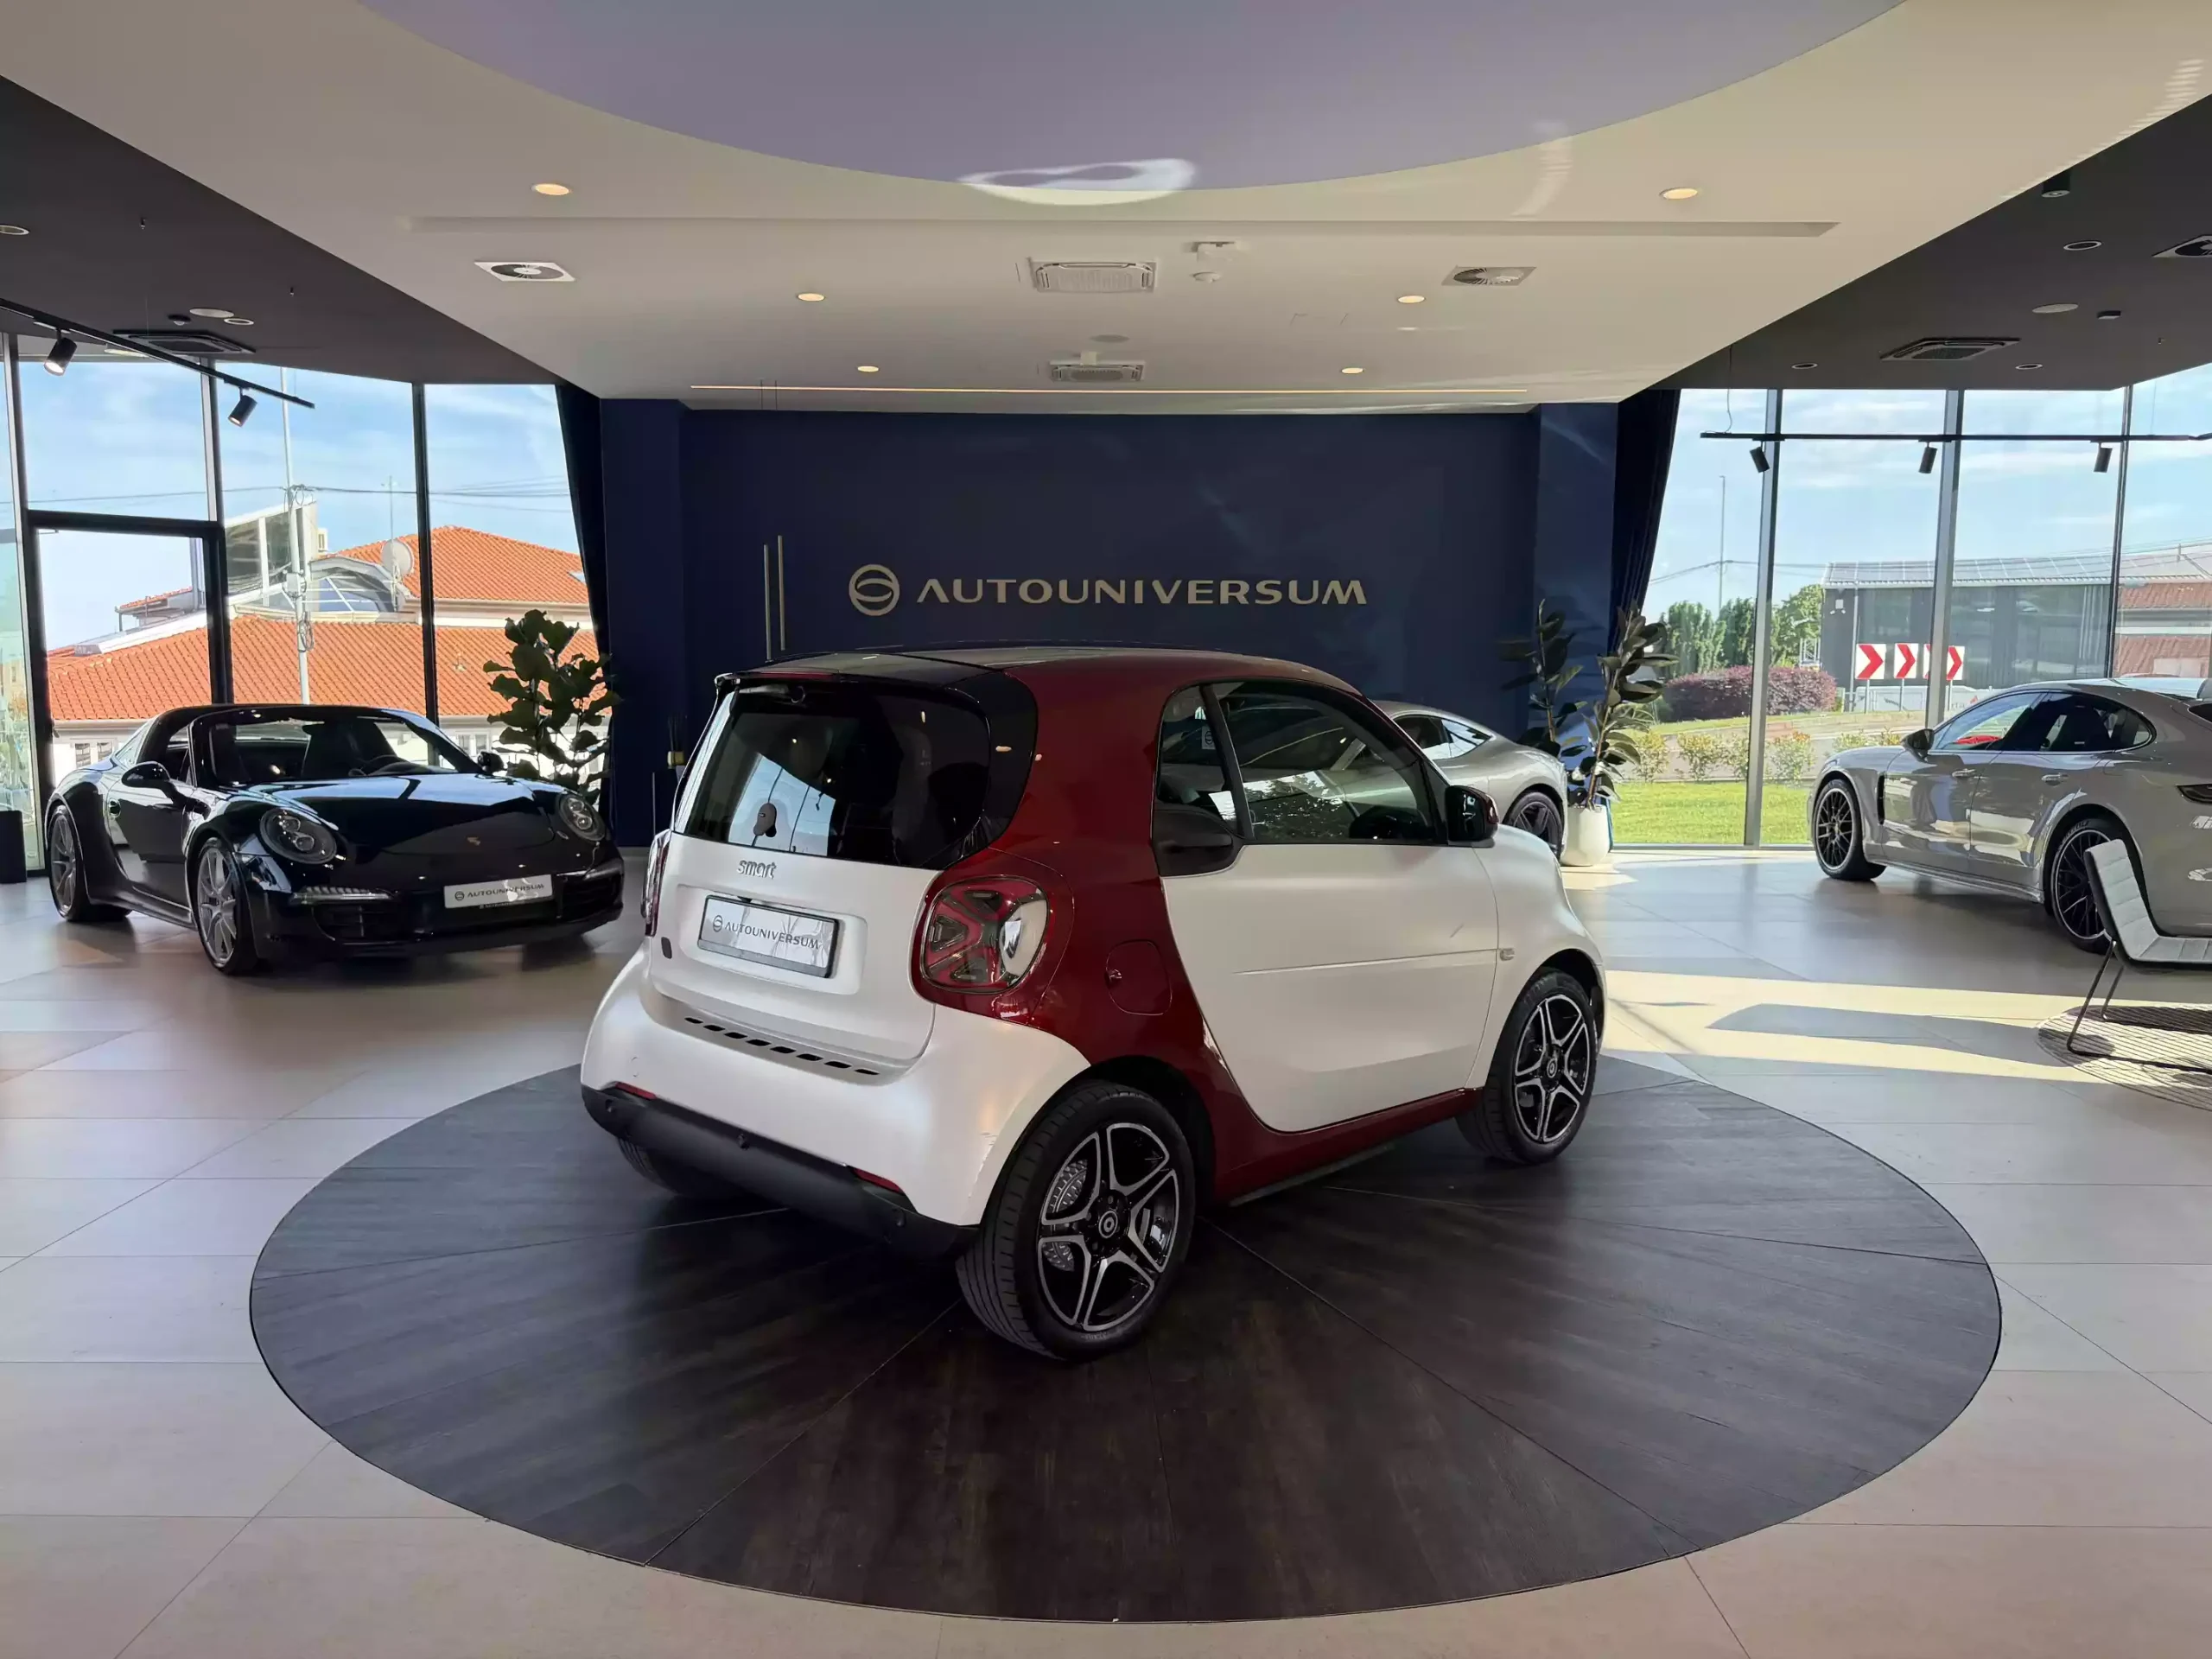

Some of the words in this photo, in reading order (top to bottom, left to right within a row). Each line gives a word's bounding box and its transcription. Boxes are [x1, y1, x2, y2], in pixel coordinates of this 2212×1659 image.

[917, 579, 1367, 604] AUTOUNIVERSUM
[738, 860, 776, 879] smart
[725, 921, 819, 949] AUTOUNIVERSUM
